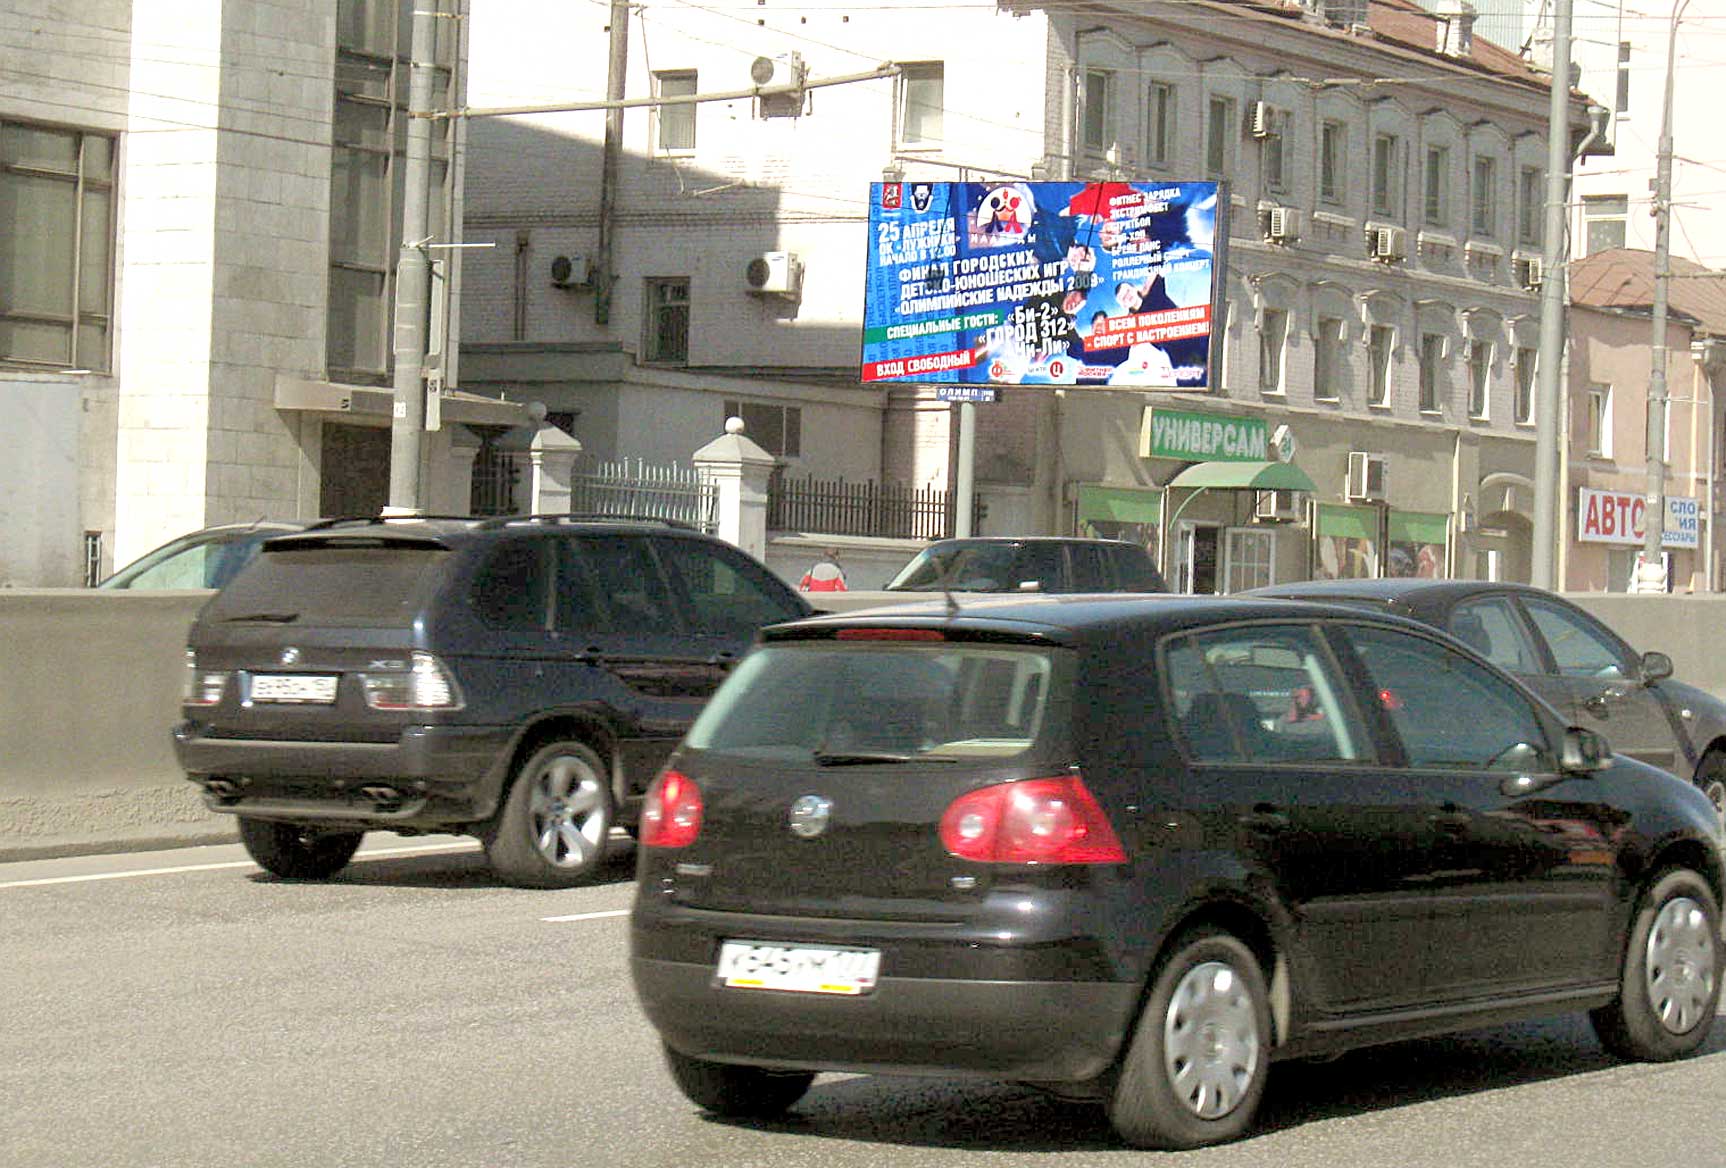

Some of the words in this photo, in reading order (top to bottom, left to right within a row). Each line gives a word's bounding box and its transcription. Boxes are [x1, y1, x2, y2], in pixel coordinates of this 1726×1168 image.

[878, 221, 900, 243] 25
[903, 217, 955, 240] АПРЕЛЯ
[879, 251, 918, 267] НАЧАЛО
[899, 261, 949, 282] ФИНАЛ
[953, 249, 1036, 275] ГОРОДСКИХ
[901, 265, 1040, 300] ДЕТСКО-ЮНОШЕСКИХ
[997, 278, 1064, 302] НАДЕЖДЫ
[886, 317, 960, 340] СПЕЦИАЛЬНЫЕ
[963, 312, 999, 328] ГОСТИ:
[1108, 316, 1137, 332] ВСЕМ
[1139, 307, 1205, 327] ПОКОЛЕНИЯМ
[1094, 333, 1125, 348] СПОРТ
[1127, 331, 1135, 344] С
[1136, 321, 1209, 341] НАСТРОЕНИЕМ!
[876, 360, 905, 377] ВХОД
[907, 350, 970, 373] СВОБОДНЫЙ
[939, 387, 978, 397] ОЛИМП
[1152, 415, 1265, 459] УНИВЕРСАМ
